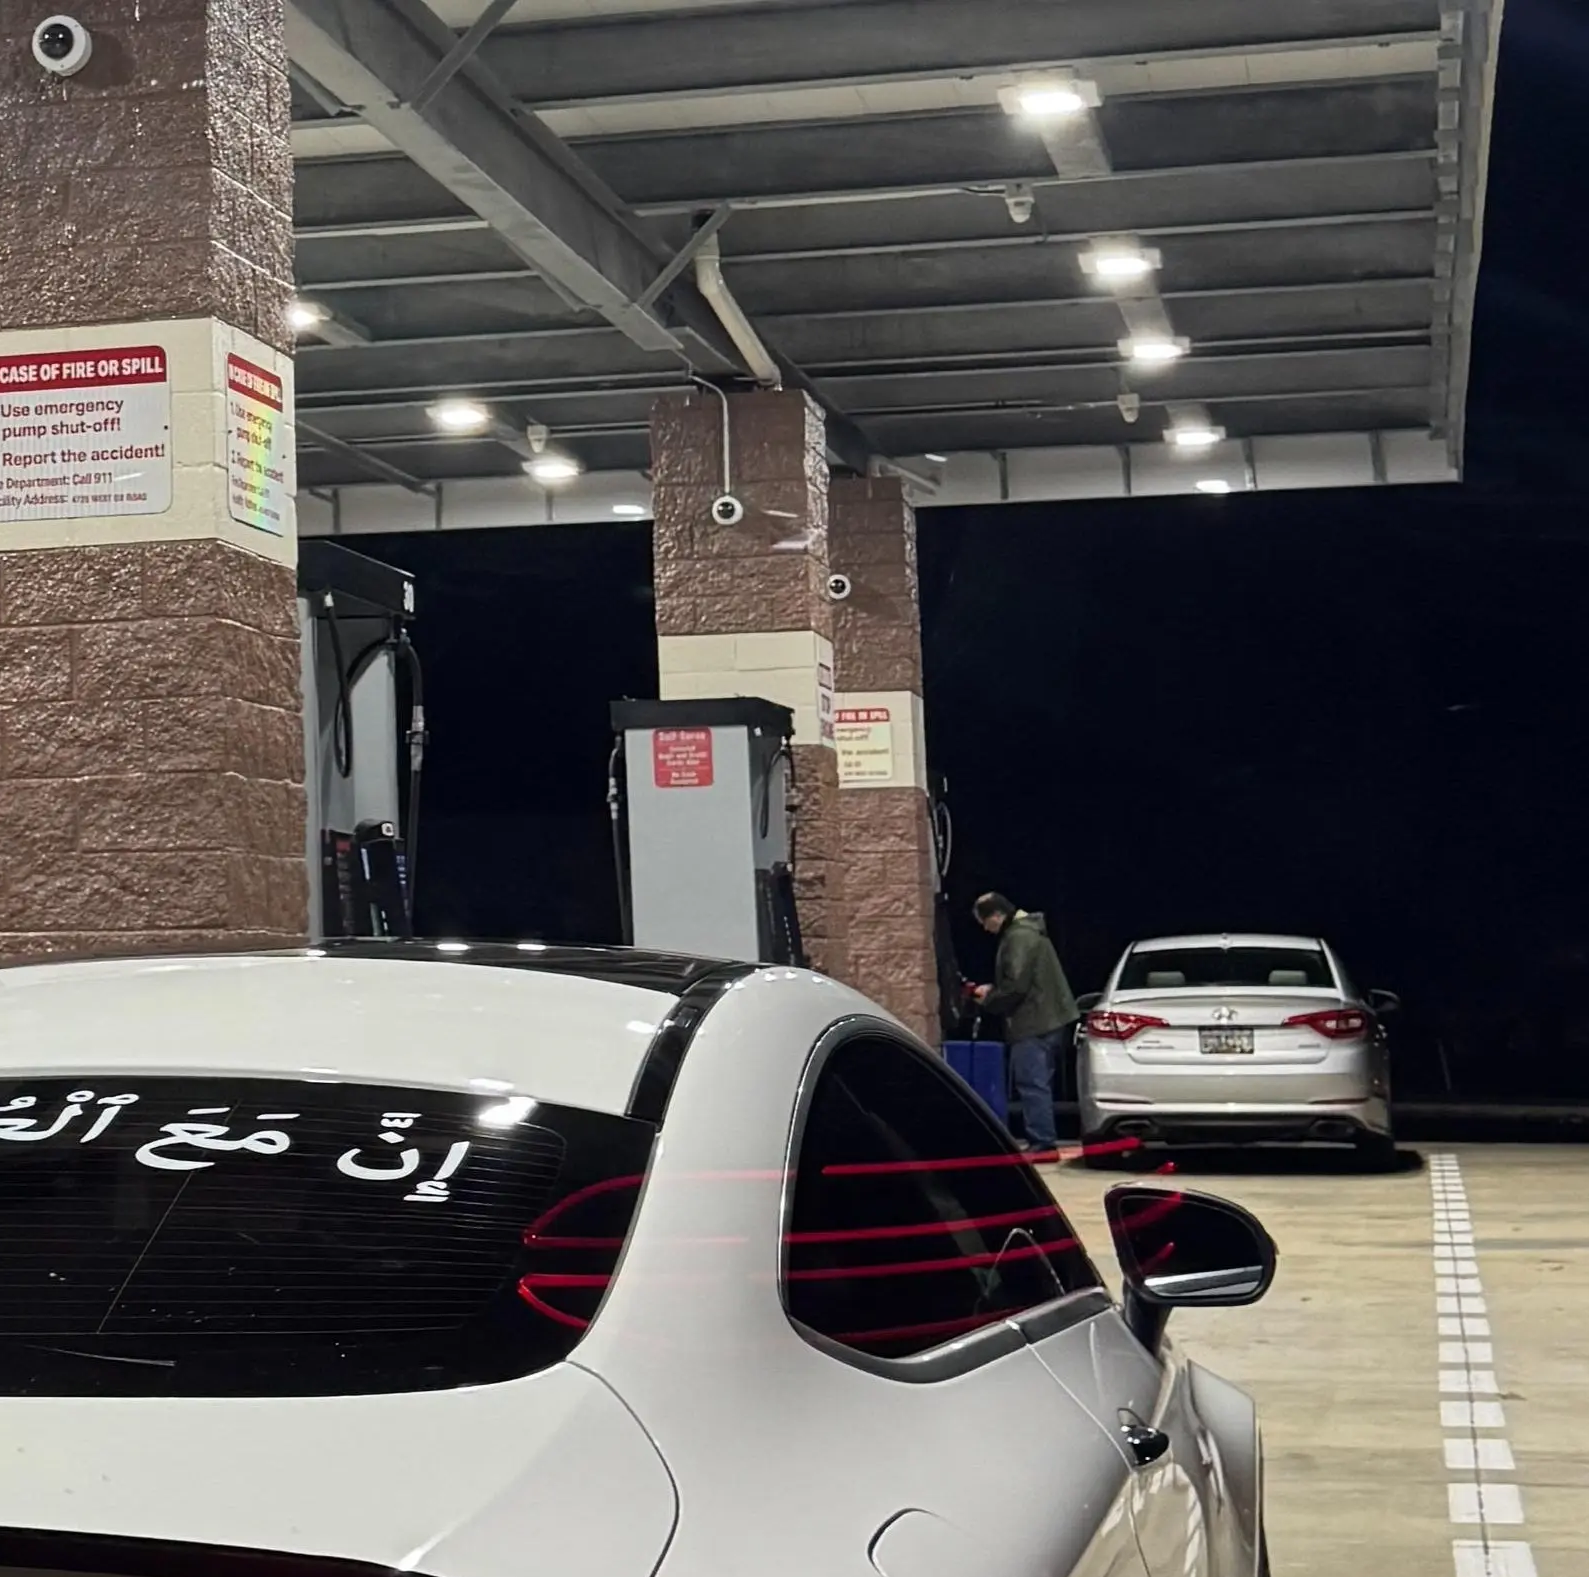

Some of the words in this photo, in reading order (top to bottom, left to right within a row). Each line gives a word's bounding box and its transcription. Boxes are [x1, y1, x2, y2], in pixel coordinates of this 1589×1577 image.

[0, 365, 37, 384] CASE
[40, 363, 60, 381] OF
[62, 361, 96, 380] FIRE
[97, 359, 120, 377] OR
[122, 356, 164, 375] SPILL
[0, 403, 30, 418] Use
[34, 400, 124, 418] emergency
[2, 422, 47, 441] pump
[52, 417, 121, 436] shut-off!
[2, 451, 57, 468] Report
[61, 450, 87, 463] the
[91, 444, 165, 462] accident!
[6, 475, 70, 491] Department:
[72, 474, 92, 485] Call
[94, 472, 112, 484] 911
